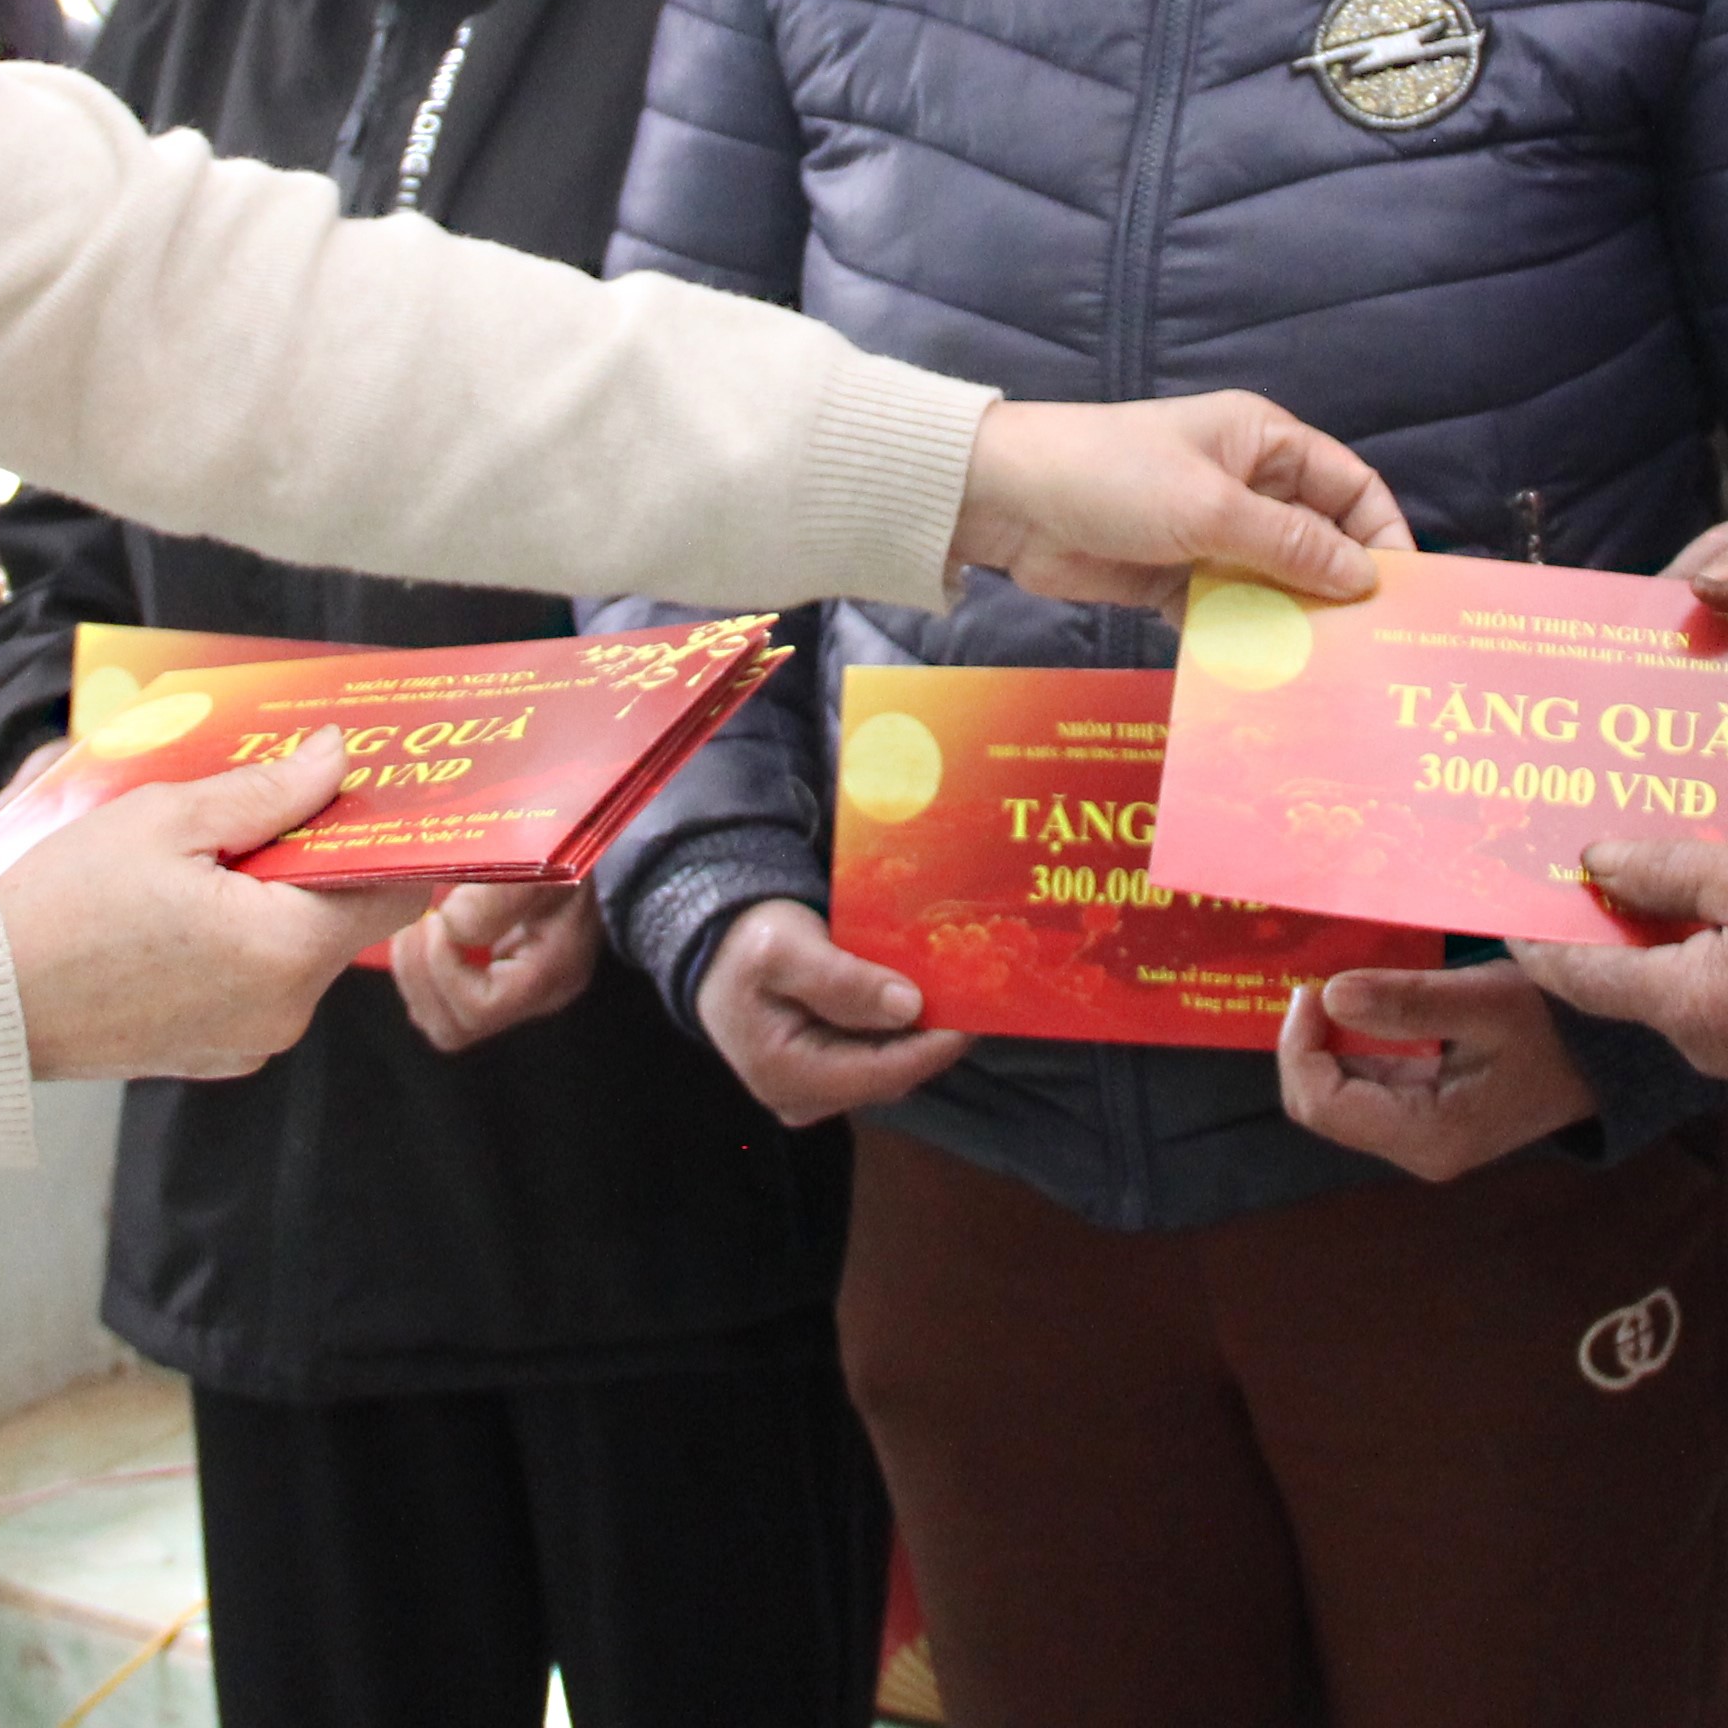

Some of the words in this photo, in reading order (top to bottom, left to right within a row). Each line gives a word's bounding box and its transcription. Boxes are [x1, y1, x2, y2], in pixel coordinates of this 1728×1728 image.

[1460, 608, 1526, 632] NHÓM
[402, 706, 535, 755] QUÀ
[1388, 681, 1581, 745] TẶNG
[375, 758, 472, 787] VNĐ
[1413, 752, 1597, 807] 300.000
[1605, 770, 1719, 819] VNĐ
[1002, 792, 1159, 852] TẶNG
